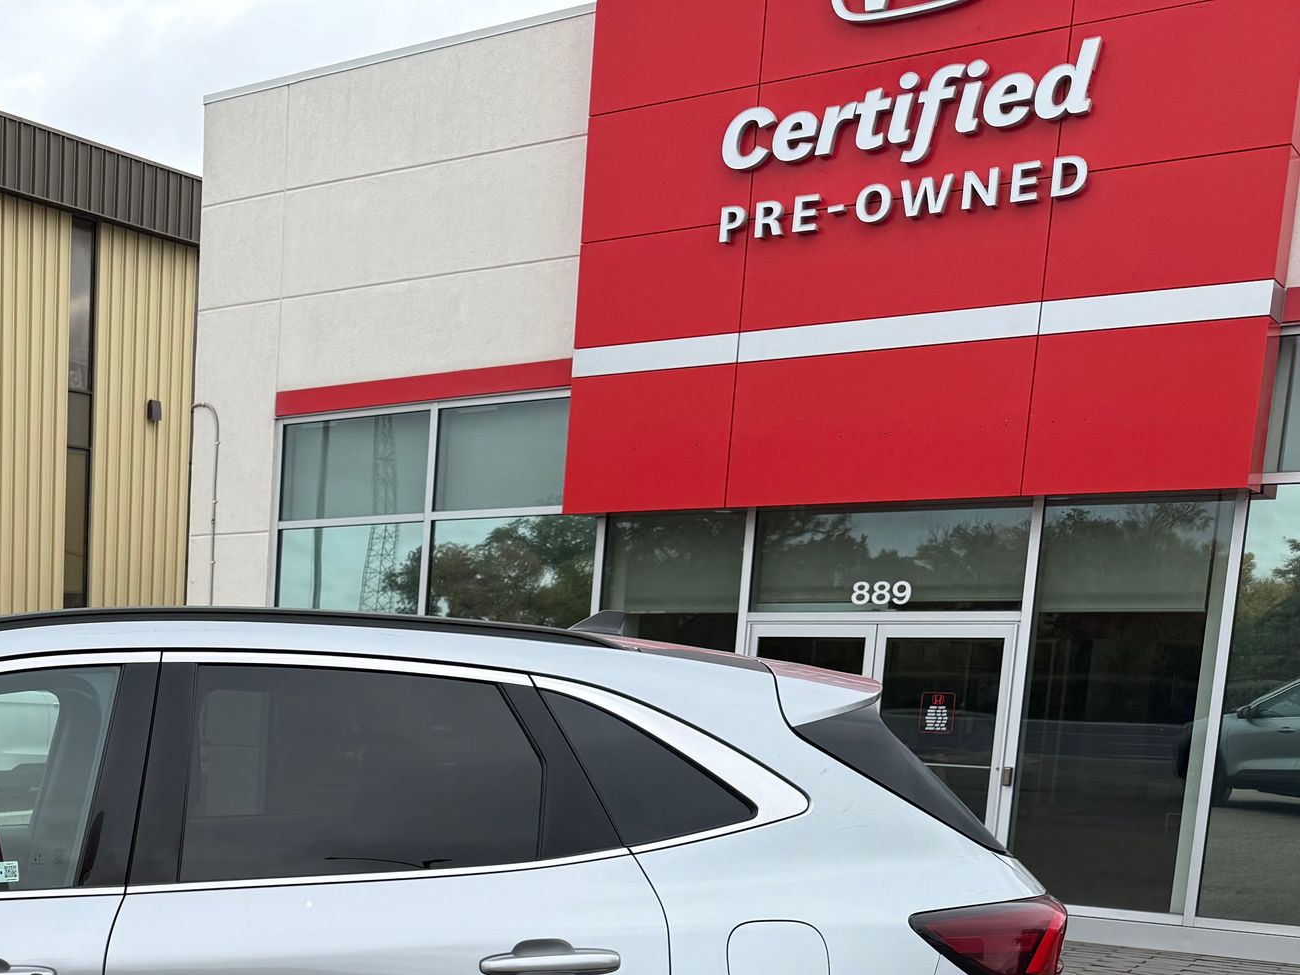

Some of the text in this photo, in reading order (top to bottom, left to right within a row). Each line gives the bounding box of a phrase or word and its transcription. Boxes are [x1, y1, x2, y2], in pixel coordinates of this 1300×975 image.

[721, 35, 1102, 171] Certified
[718, 154, 1089, 244] PRE-OWNED
[851, 580, 912, 605] 889
